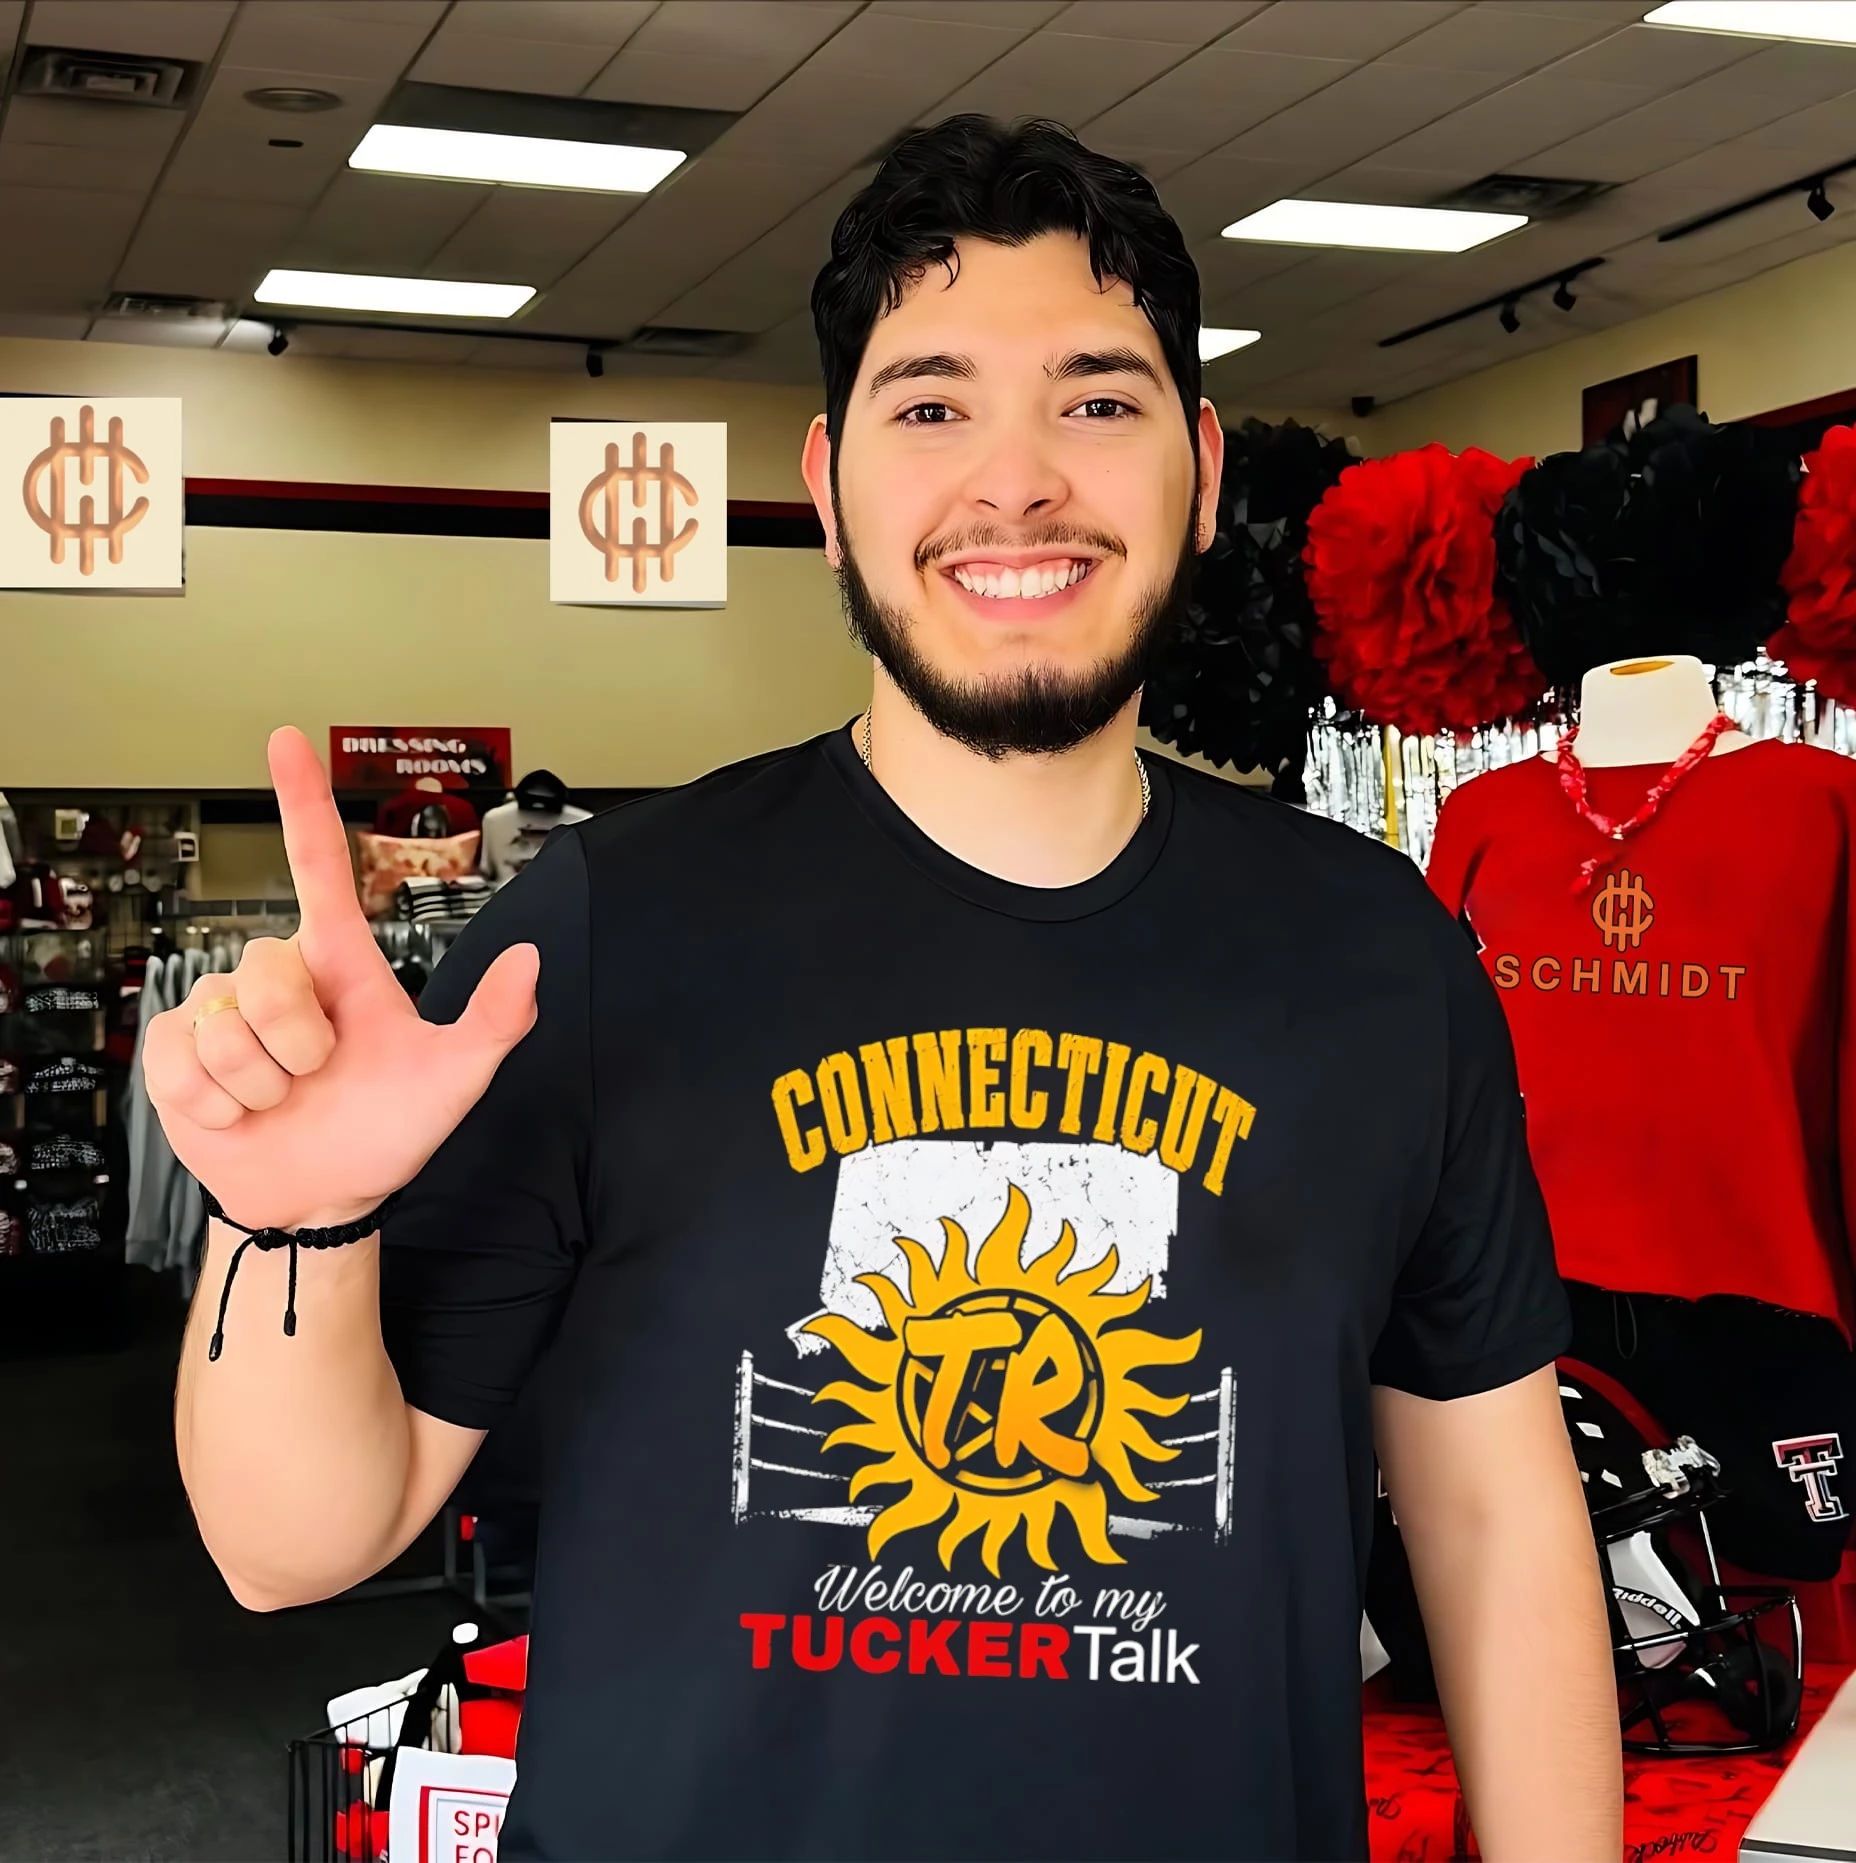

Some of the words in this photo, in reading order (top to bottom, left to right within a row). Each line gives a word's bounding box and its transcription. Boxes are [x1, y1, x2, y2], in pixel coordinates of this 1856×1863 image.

[396, 758, 487, 775] ROOMS
[1494, 953, 1747, 1000] SCHMIDT
[771, 1027, 1257, 1197] CONNECTICUT
[813, 1564, 1024, 1617] Welcome
[1034, 1573, 1084, 1618] to
[1092, 1586, 1167, 1632] my
